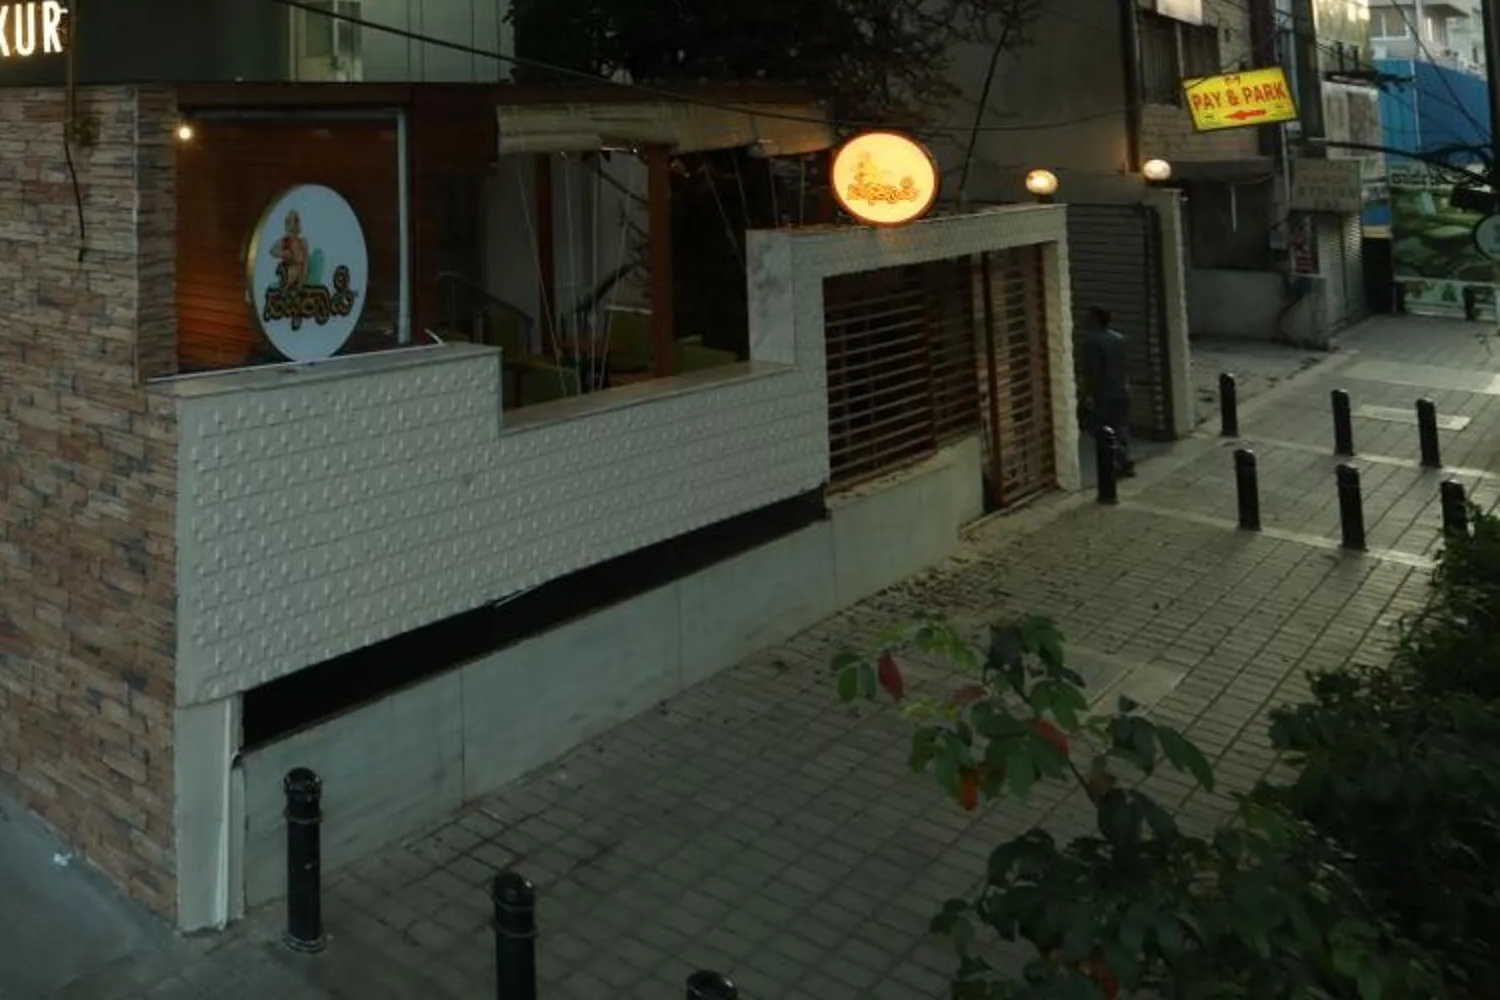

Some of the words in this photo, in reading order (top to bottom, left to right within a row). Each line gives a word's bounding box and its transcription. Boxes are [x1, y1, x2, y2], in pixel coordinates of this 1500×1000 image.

[1191, 91, 1221, 111] PAY
[1226, 88, 1240, 107] &
[1242, 81, 1286, 104] PARK
